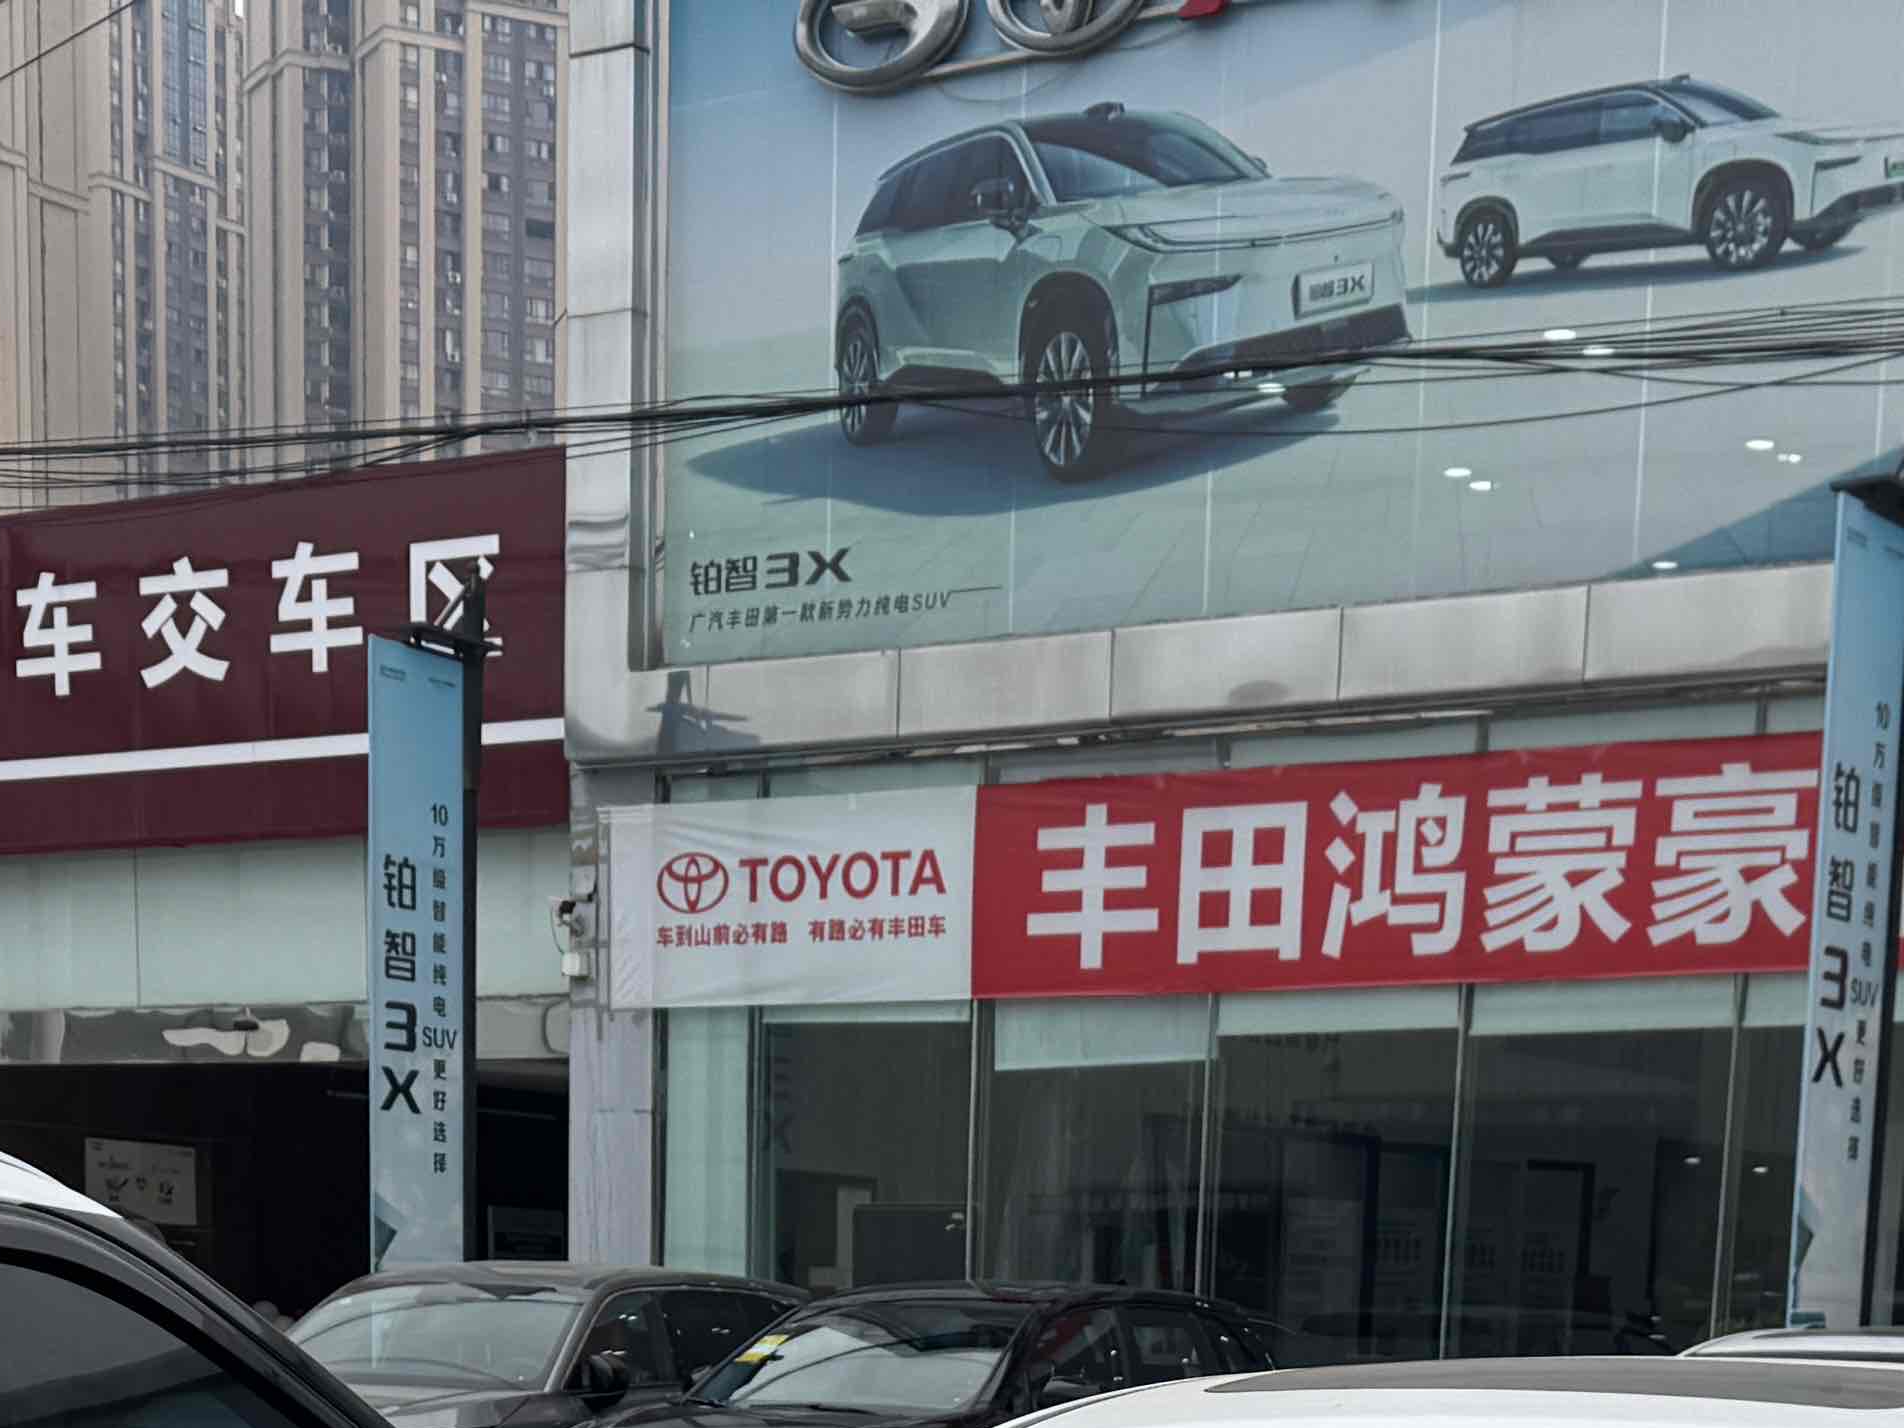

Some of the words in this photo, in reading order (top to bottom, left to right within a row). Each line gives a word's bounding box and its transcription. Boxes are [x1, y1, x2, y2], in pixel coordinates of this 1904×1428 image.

[690, 546, 853, 597] 铂智3X
[739, 848, 947, 903] TOYOTA
[657, 920, 789, 948] 车到山前必有路
[808, 914, 947, 944] 有路必有丰田车
[1811, 762, 1863, 1088] 铂智3X
[381, 853, 422, 1114] 铂智3X
